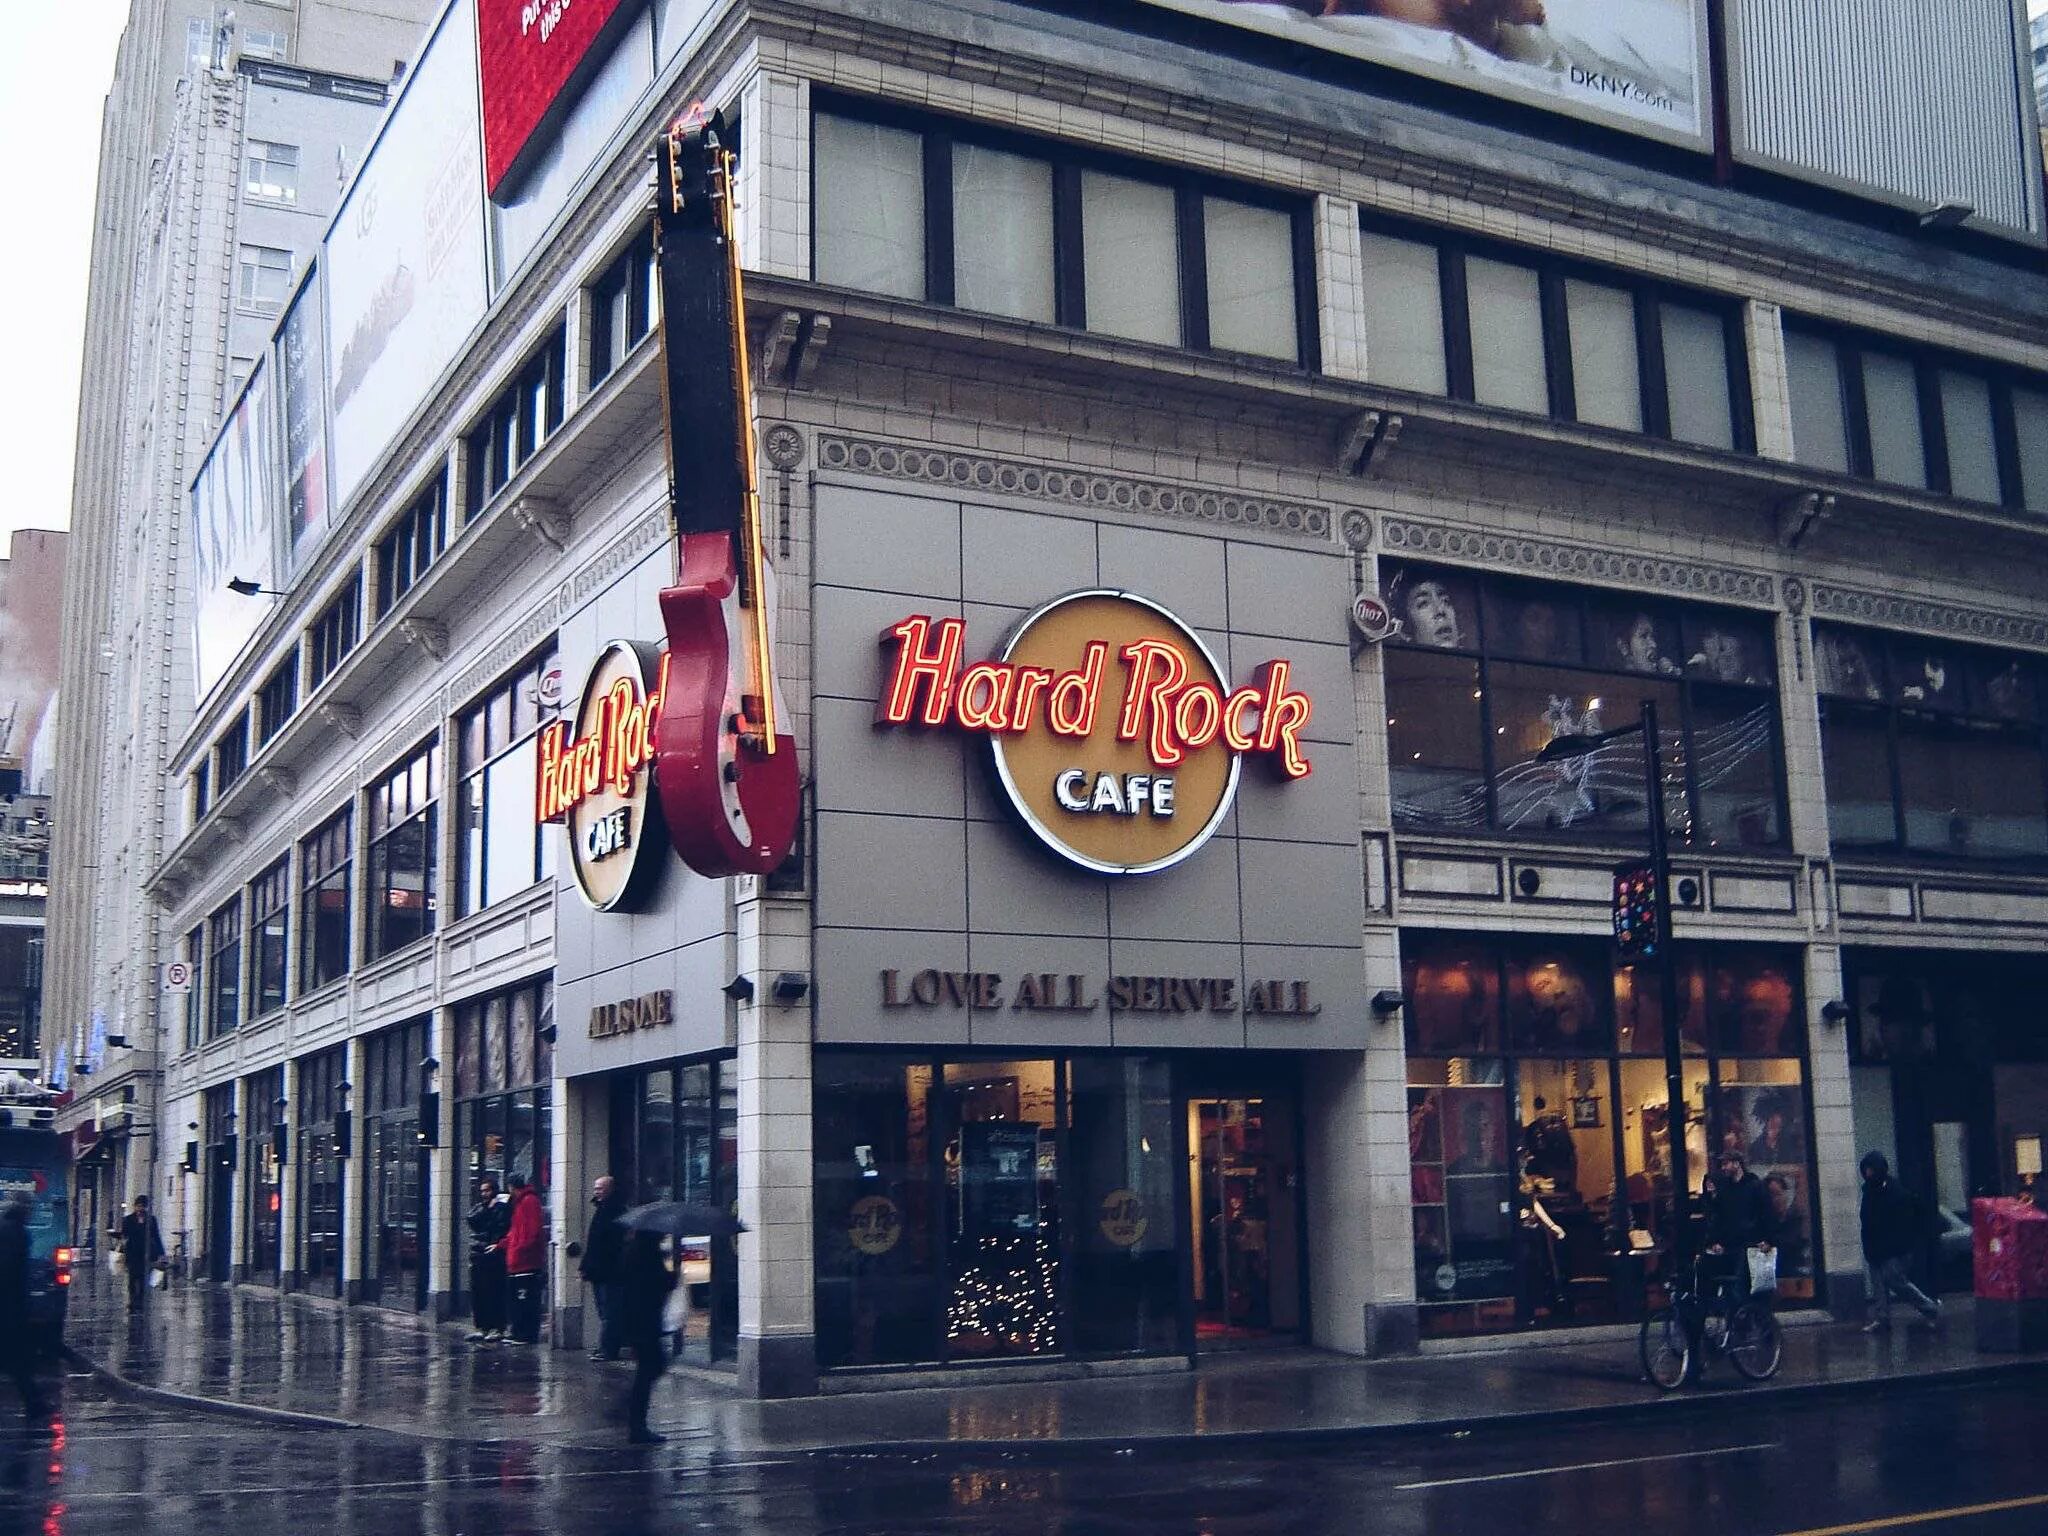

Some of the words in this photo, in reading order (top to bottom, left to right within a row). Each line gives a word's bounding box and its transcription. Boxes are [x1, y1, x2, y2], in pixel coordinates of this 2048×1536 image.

[1570, 65, 1673, 111] DKNY.com
[880, 613, 1108, 742] Hard
[1117, 636, 1312, 782] Rock
[538, 695, 609, 823] Hard
[1054, 767, 1176, 818] CAFE
[584, 808, 632, 864] CAFE
[880, 967, 1002, 1010] LOVE
[1012, 972, 1099, 1011] ALL
[1107, 975, 1238, 1013] SERVE
[1246, 979, 1322, 1016] ALL
